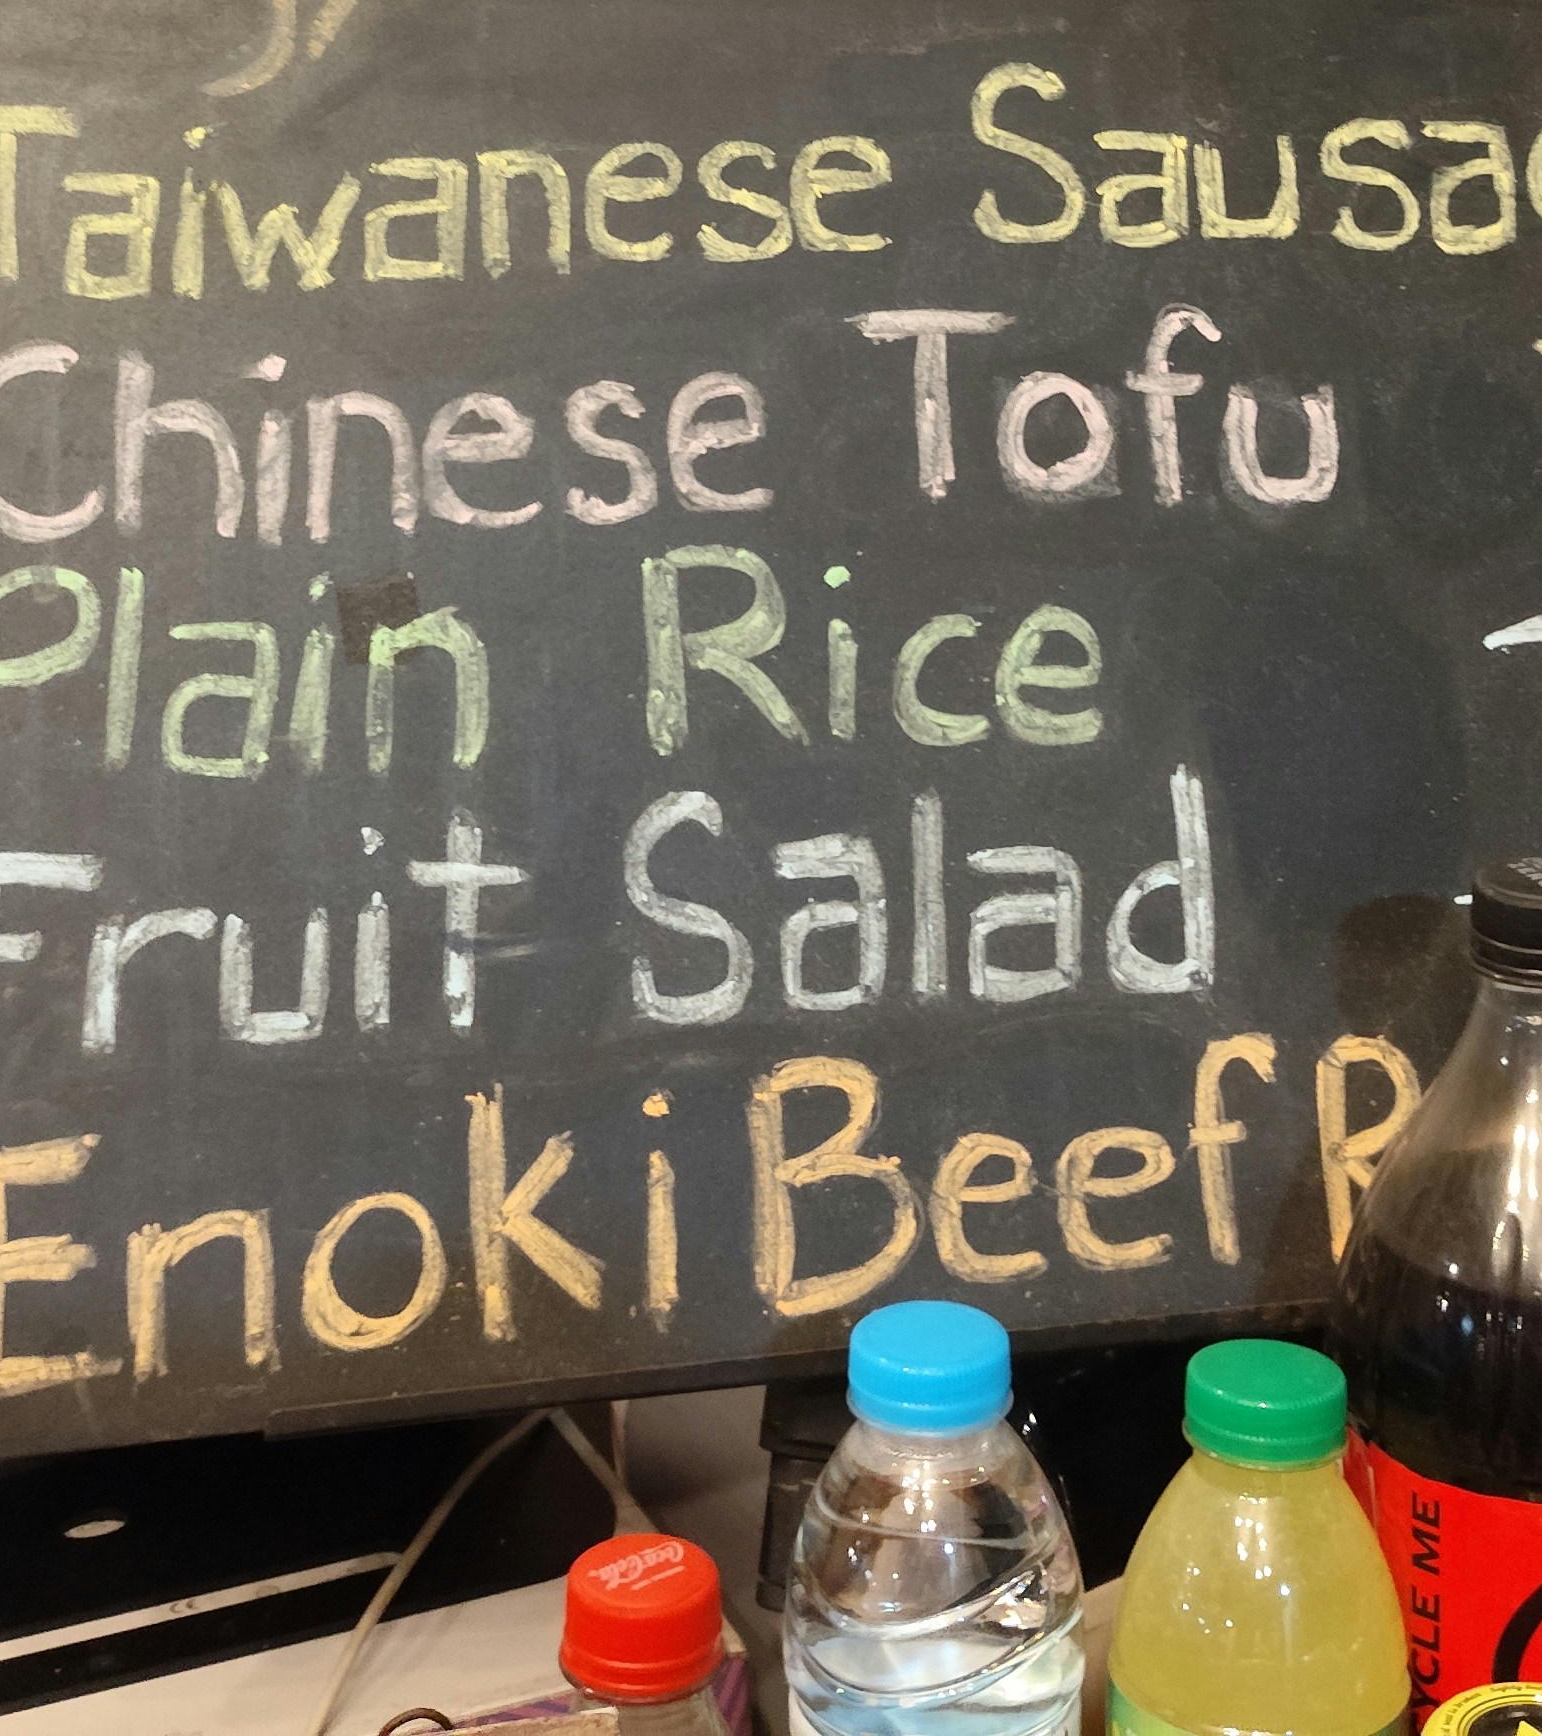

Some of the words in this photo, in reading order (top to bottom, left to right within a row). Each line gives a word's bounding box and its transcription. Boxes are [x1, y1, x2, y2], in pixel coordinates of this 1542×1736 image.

[847, 302, 1341, 508] Tofu
[641, 543, 1105, 757] Rice
[623, 763, 1216, 1025] Salad
[750, 1031, 1280, 1317] Beef
[1410, 1491, 1442, 1576] ME
